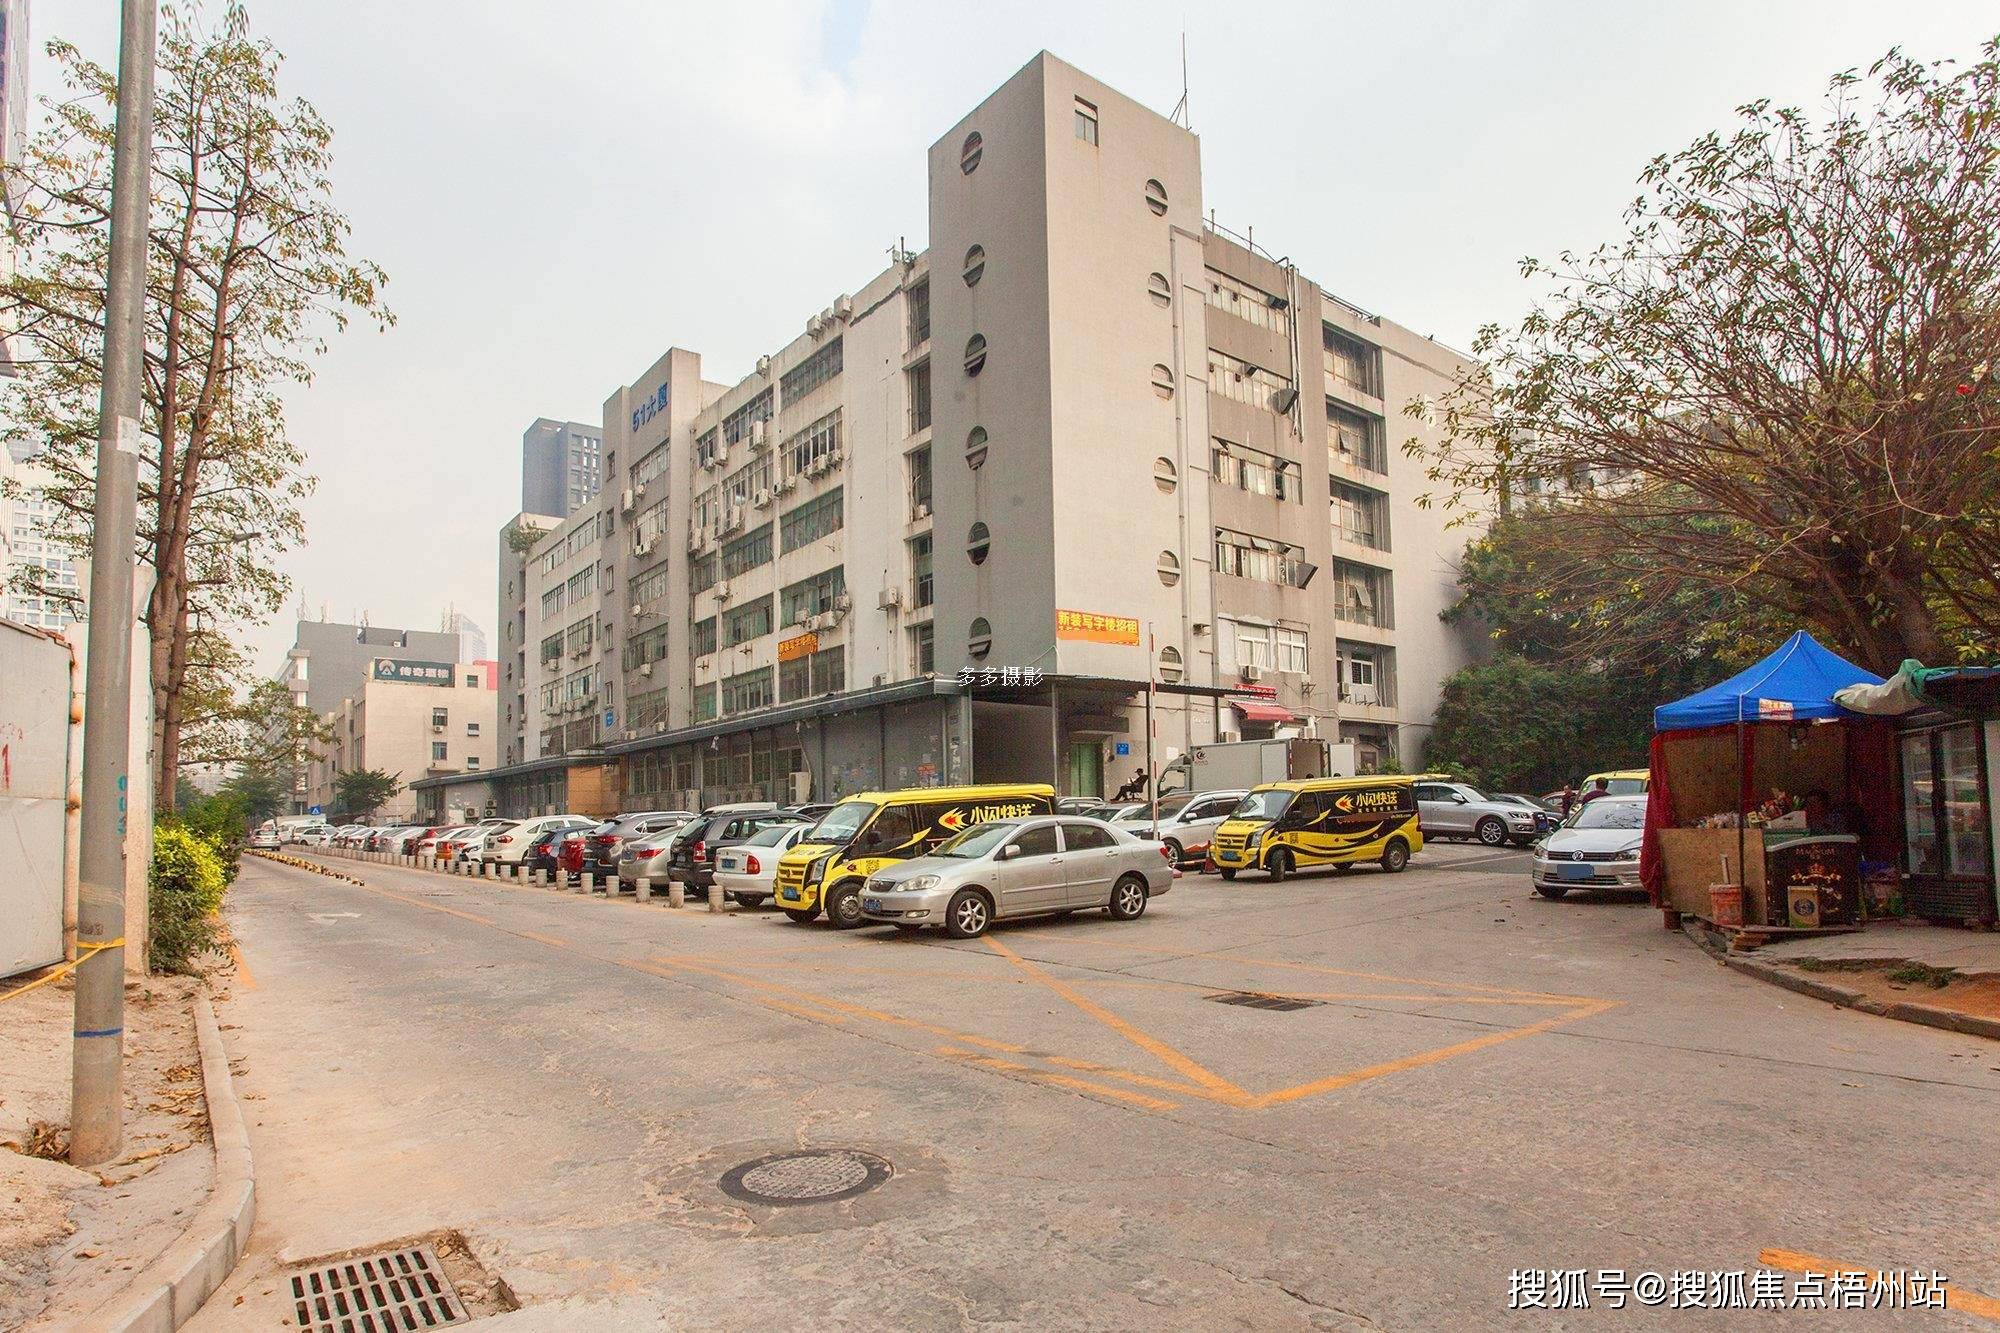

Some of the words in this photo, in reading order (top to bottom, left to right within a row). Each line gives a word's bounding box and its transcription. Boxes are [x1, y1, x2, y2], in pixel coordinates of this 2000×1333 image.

[1355, 790, 1398, 807] 小闪快送
[969, 803, 1032, 824] 小闪快送
